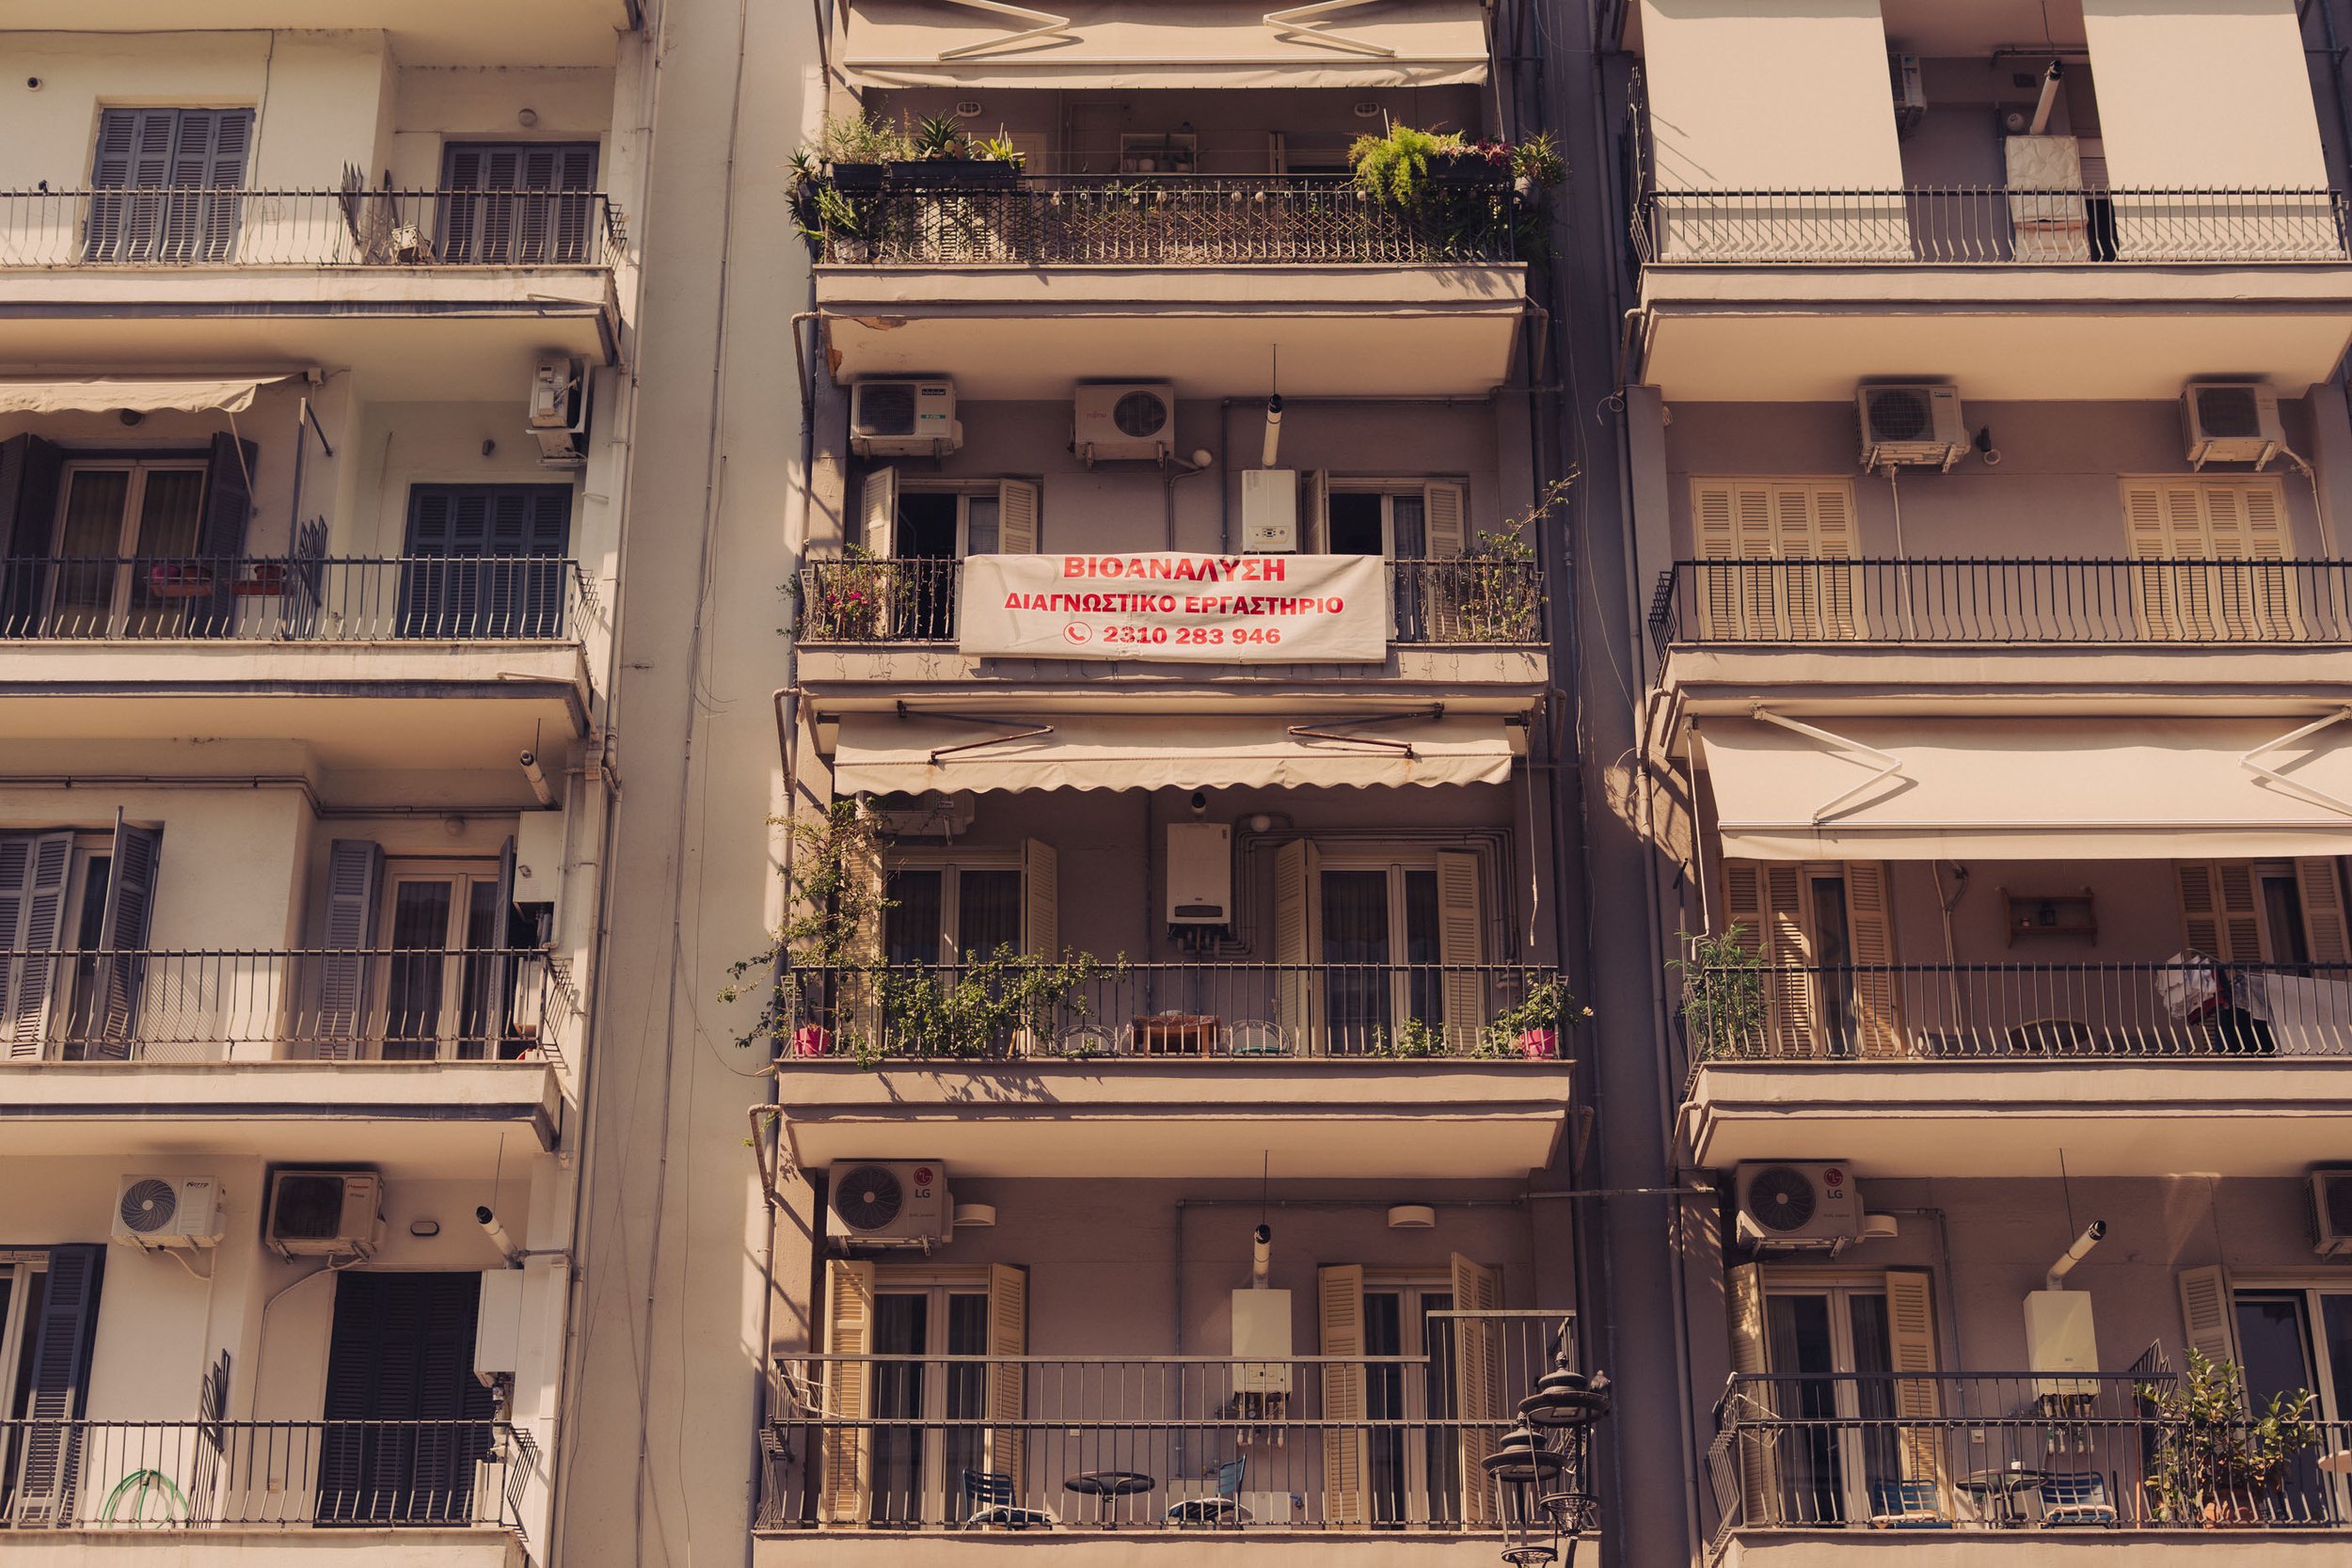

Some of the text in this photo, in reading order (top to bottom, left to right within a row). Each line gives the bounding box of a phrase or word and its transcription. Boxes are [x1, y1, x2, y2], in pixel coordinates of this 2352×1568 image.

[1063, 556, 1286, 582] ΒΙΟΑΝΑΛΥΣΗ
[1004, 592, 1345, 615] ΔΙΑΓΝΩΣΤΙΚΟ ΕΡΓΑΣΤΗΡΙΟ
[1103, 625, 1280, 645] 2310 283 946
[914, 1188, 931, 1198] LG
[1827, 1189, 1844, 1199] LG
